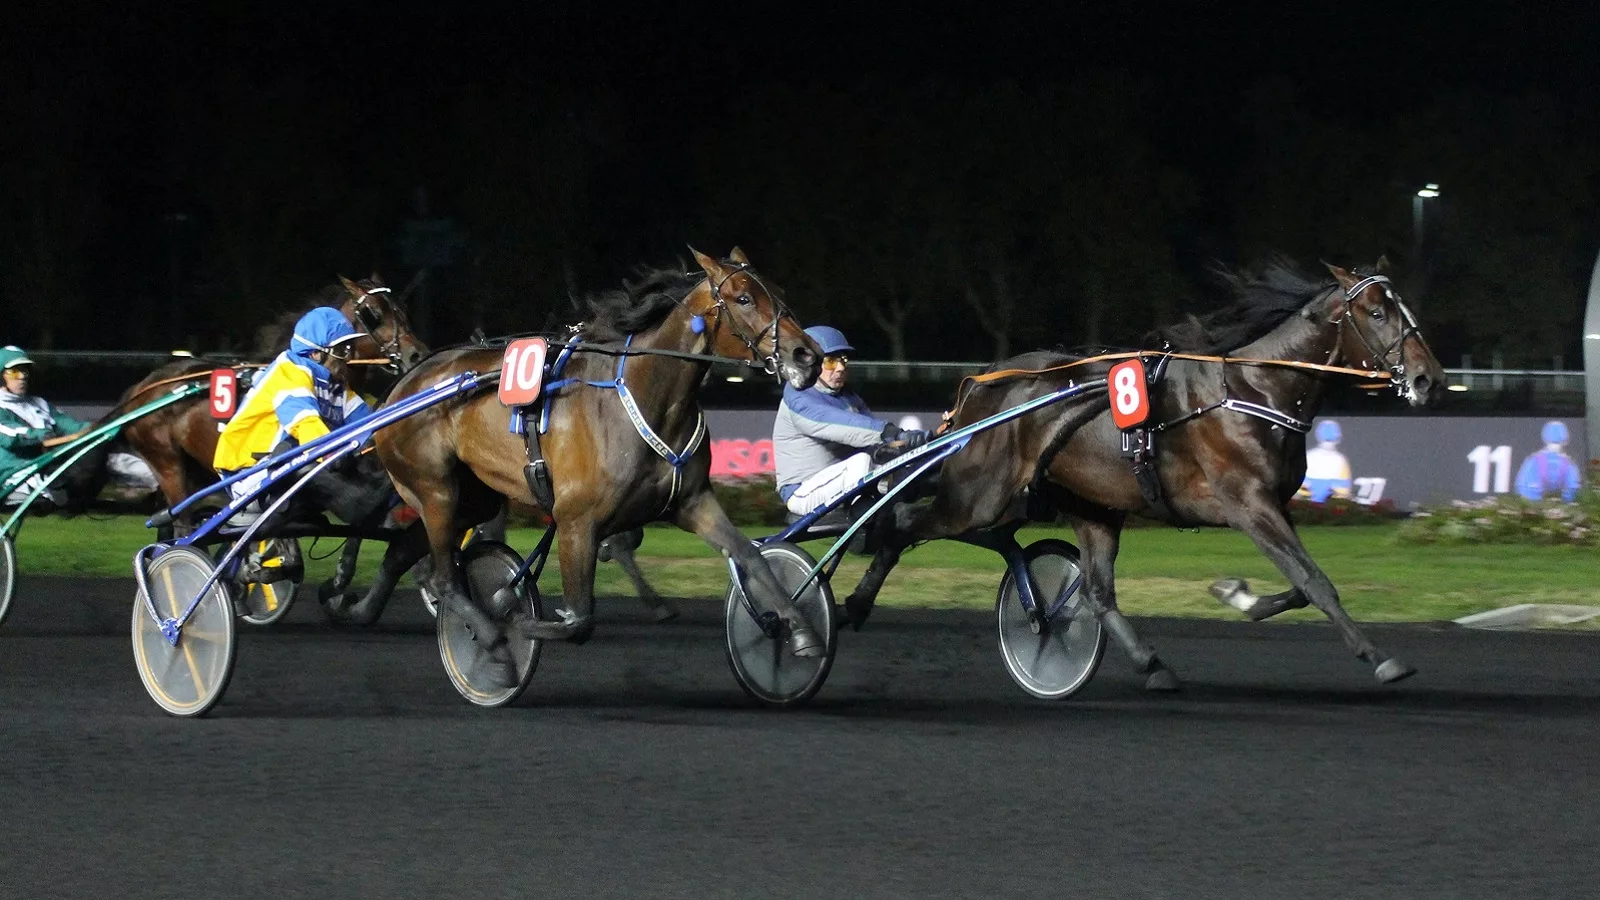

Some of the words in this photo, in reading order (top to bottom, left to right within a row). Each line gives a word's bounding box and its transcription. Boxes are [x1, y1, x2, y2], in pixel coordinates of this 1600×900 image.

[504, 344, 544, 391] 10
[213, 375, 232, 413] 5
[1114, 367, 1140, 416] 8
[1466, 445, 1512, 493] 11
